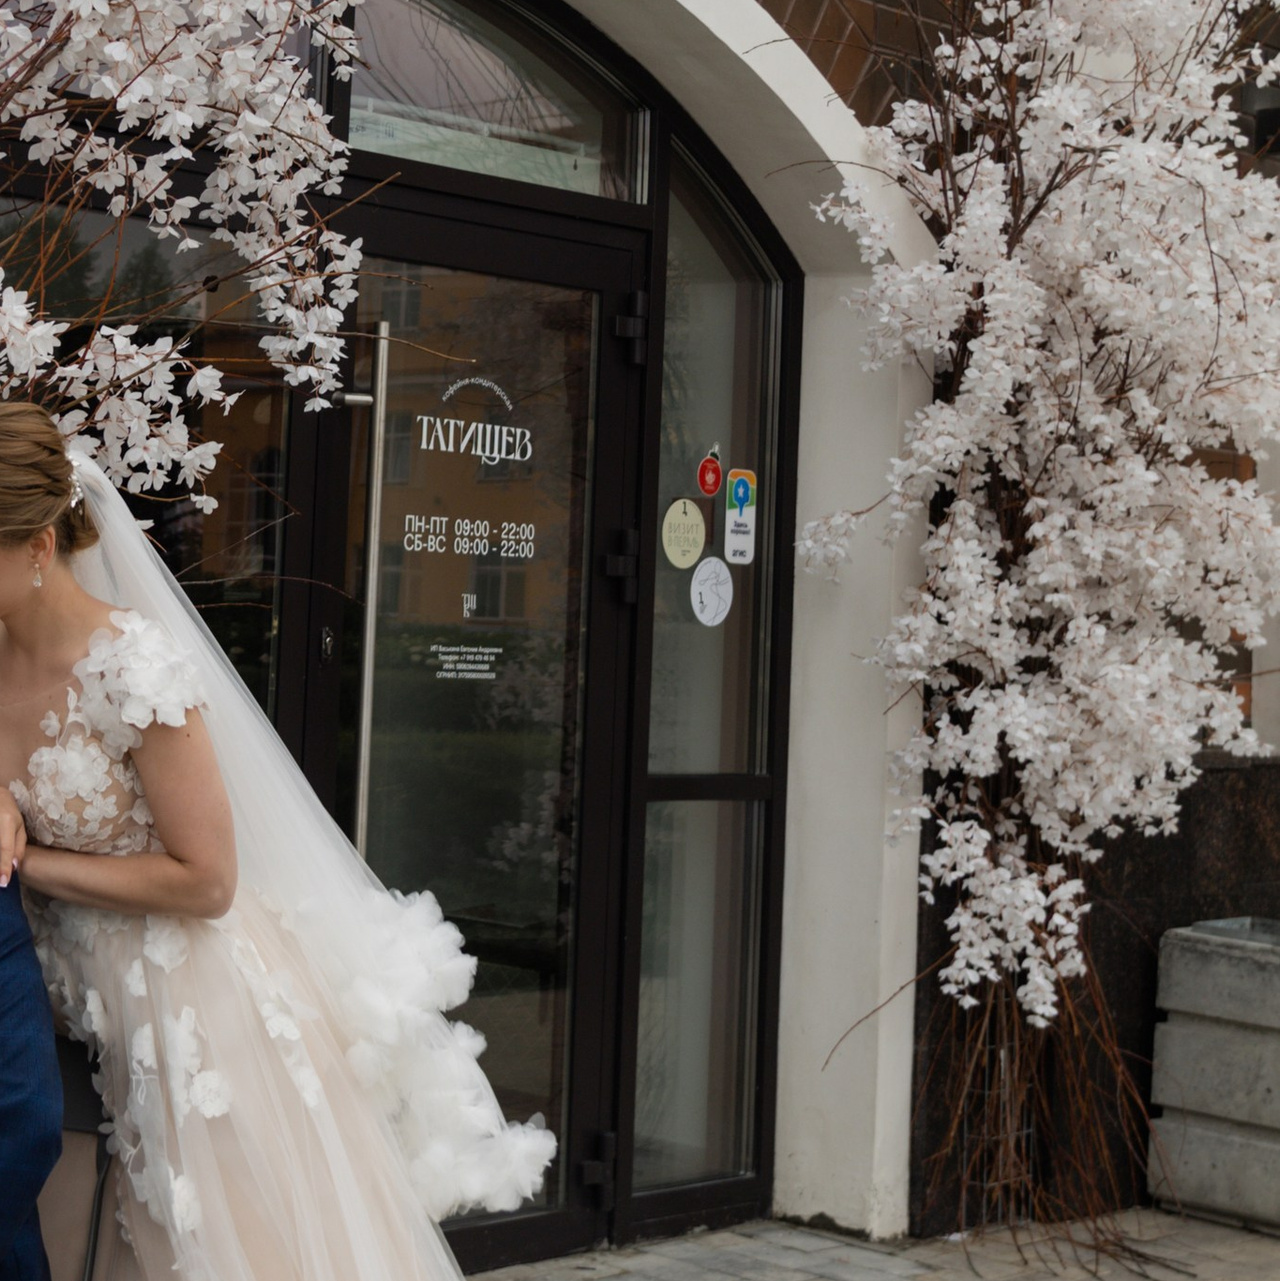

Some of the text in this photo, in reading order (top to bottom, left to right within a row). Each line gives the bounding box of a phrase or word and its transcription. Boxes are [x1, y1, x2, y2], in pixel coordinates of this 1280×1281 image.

[442, 377, 513, 411] кофейня-кондитерская
[416, 415, 533, 465] ТАТИЩЕВ
[405, 515, 449, 534] ПН-ПТ
[454, 519, 489, 537] 09:00
[500, 522, 535, 540] 22:00
[668, 522, 700, 535] ВИЗИТ
[404, 533, 446, 552] СБ-ВС
[453, 537, 489, 555] 09:00
[500, 540, 534, 558] 22:00
